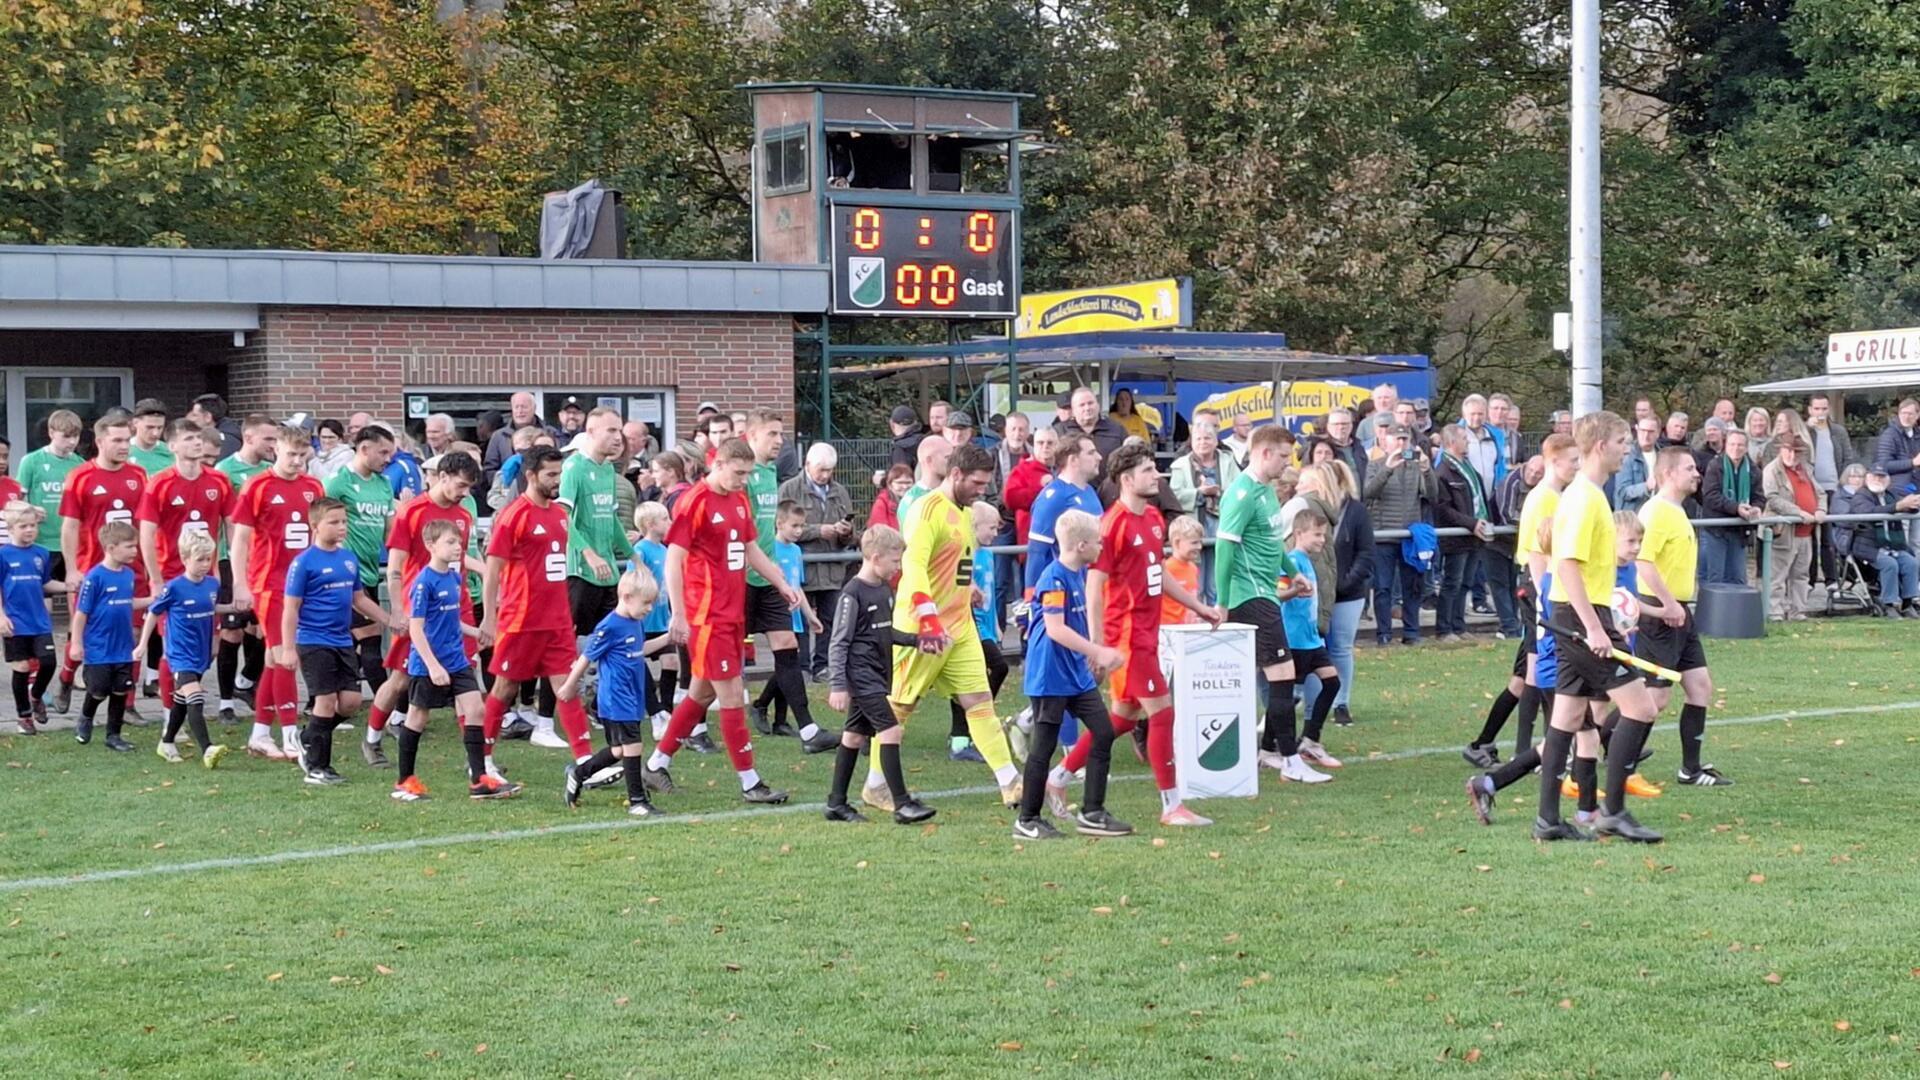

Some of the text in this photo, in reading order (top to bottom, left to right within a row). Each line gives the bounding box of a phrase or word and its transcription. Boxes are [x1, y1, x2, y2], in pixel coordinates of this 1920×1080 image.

[854, 207, 881, 250] 0
[968, 211, 995, 253] 0
[961, 278, 1005, 297] Gast
[1856, 337, 1908, 362] GRILL
[1192, 678, 1242, 691] HOLLER
[1201, 718, 1223, 741] FC
